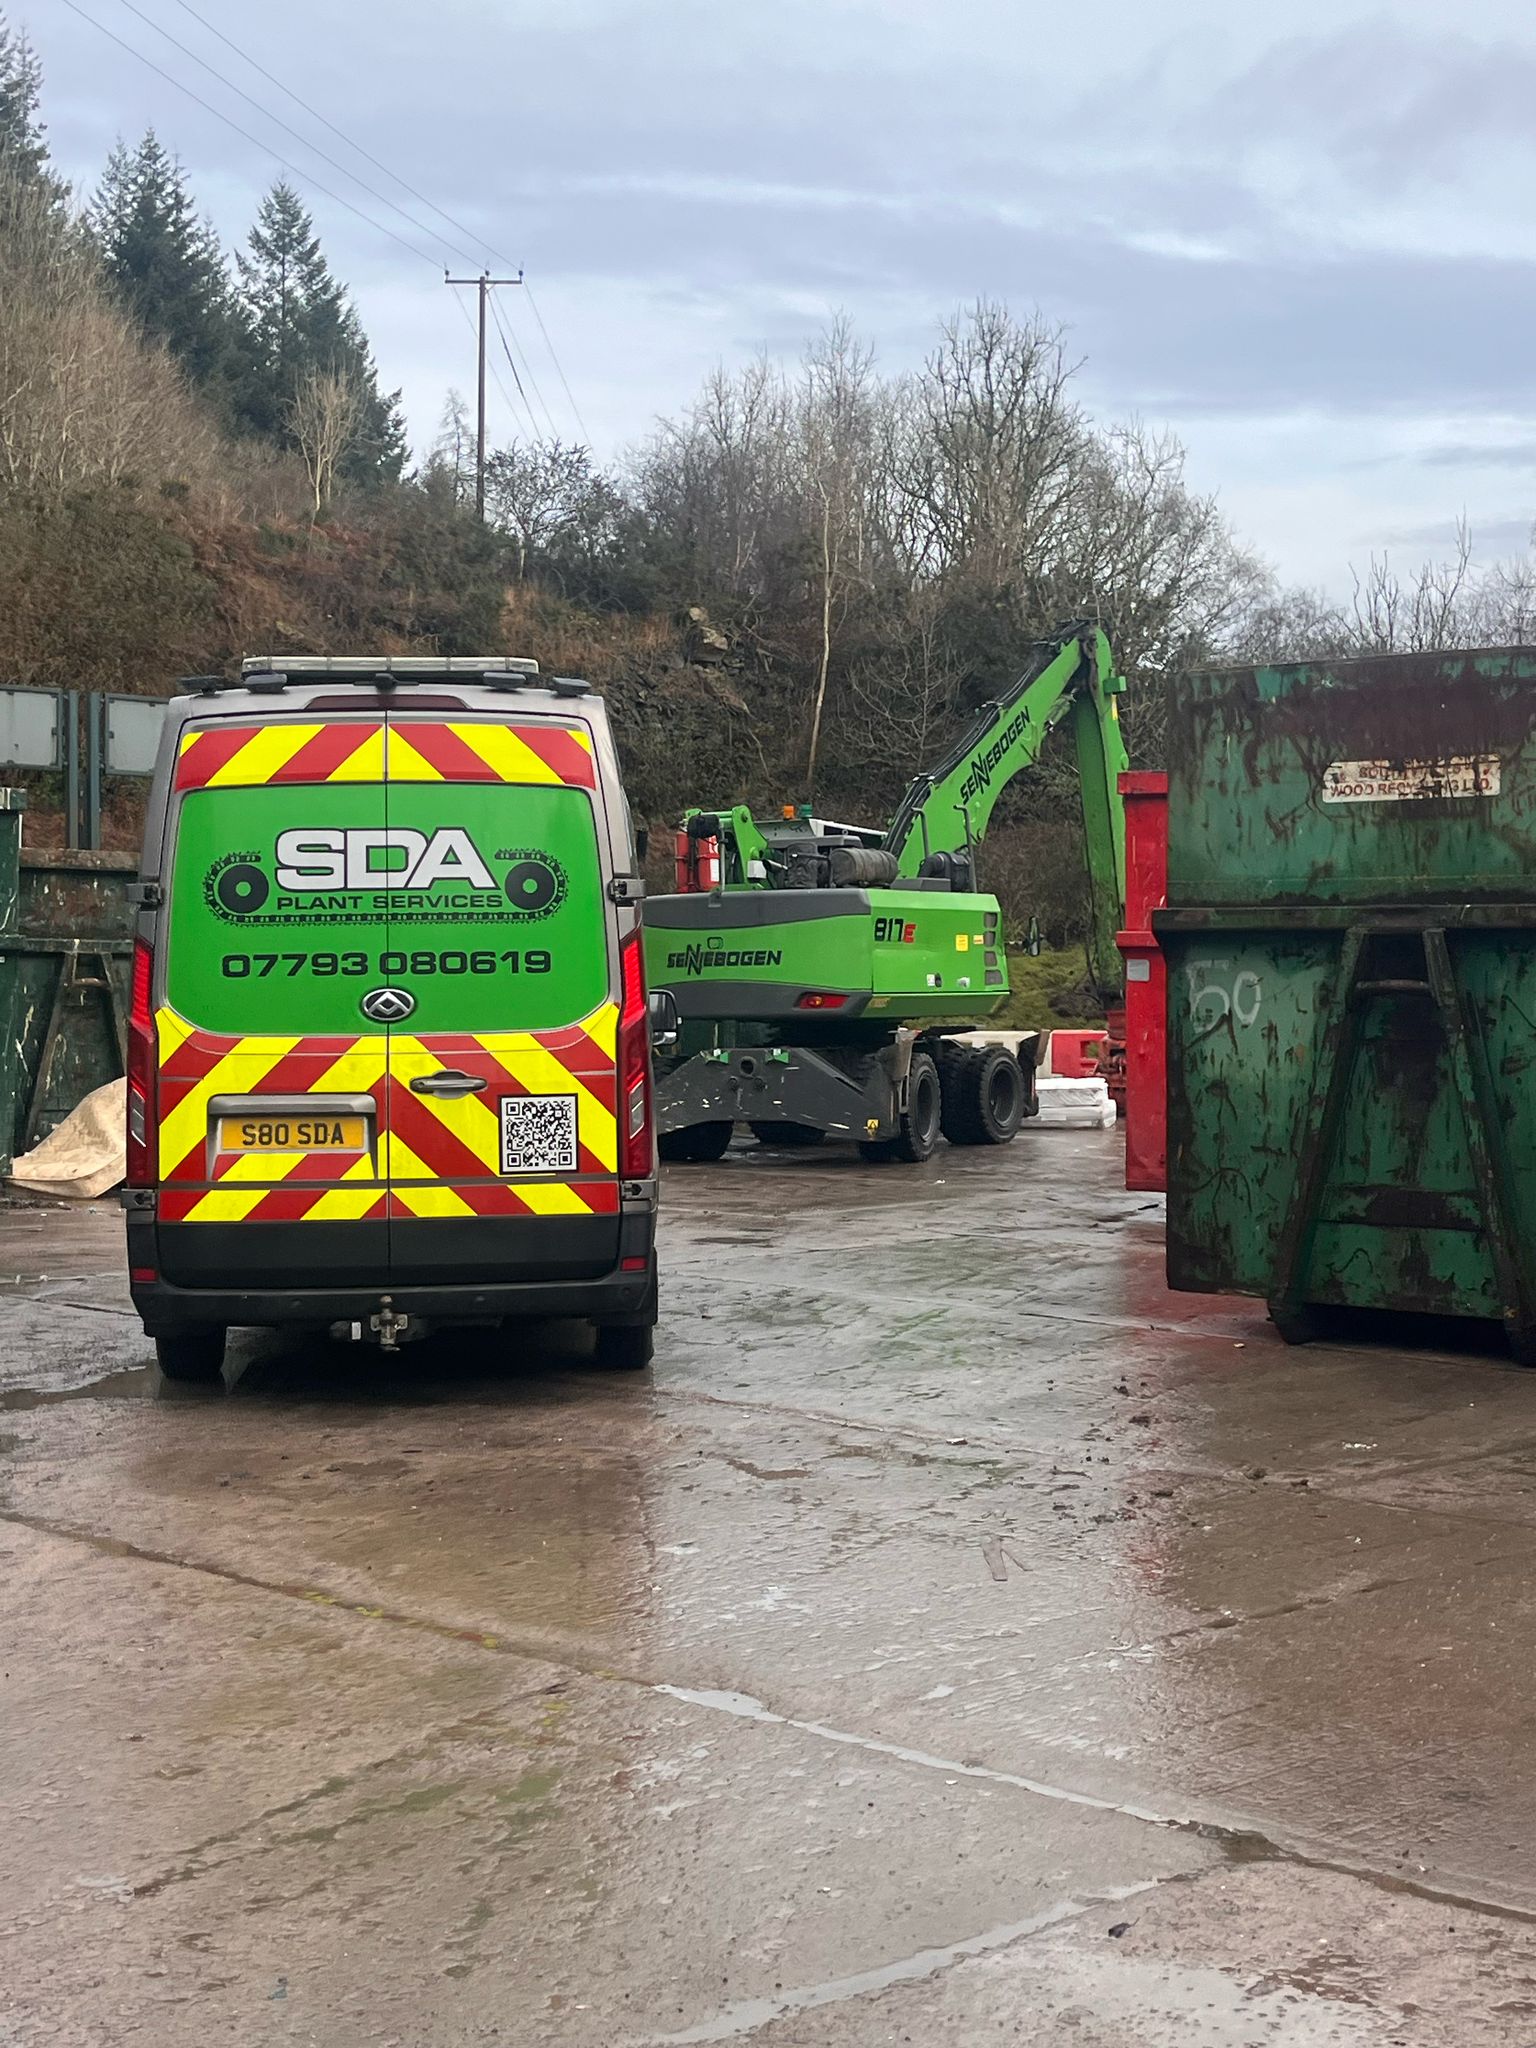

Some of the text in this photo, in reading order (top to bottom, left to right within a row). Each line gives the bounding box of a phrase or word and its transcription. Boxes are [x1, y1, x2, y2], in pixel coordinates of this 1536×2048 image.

[960, 705, 1031, 805] SENNEBOGEN
[275, 827, 501, 892] SDA
[277, 894, 503, 910] PLANT SERVICES
[222, 950, 551, 977] 07793 080619
[667, 943, 782, 976] SENNEBOGEN
[1186, 959, 1262, 1034] 50
[242, 1122, 344, 1146] S80 SDA
